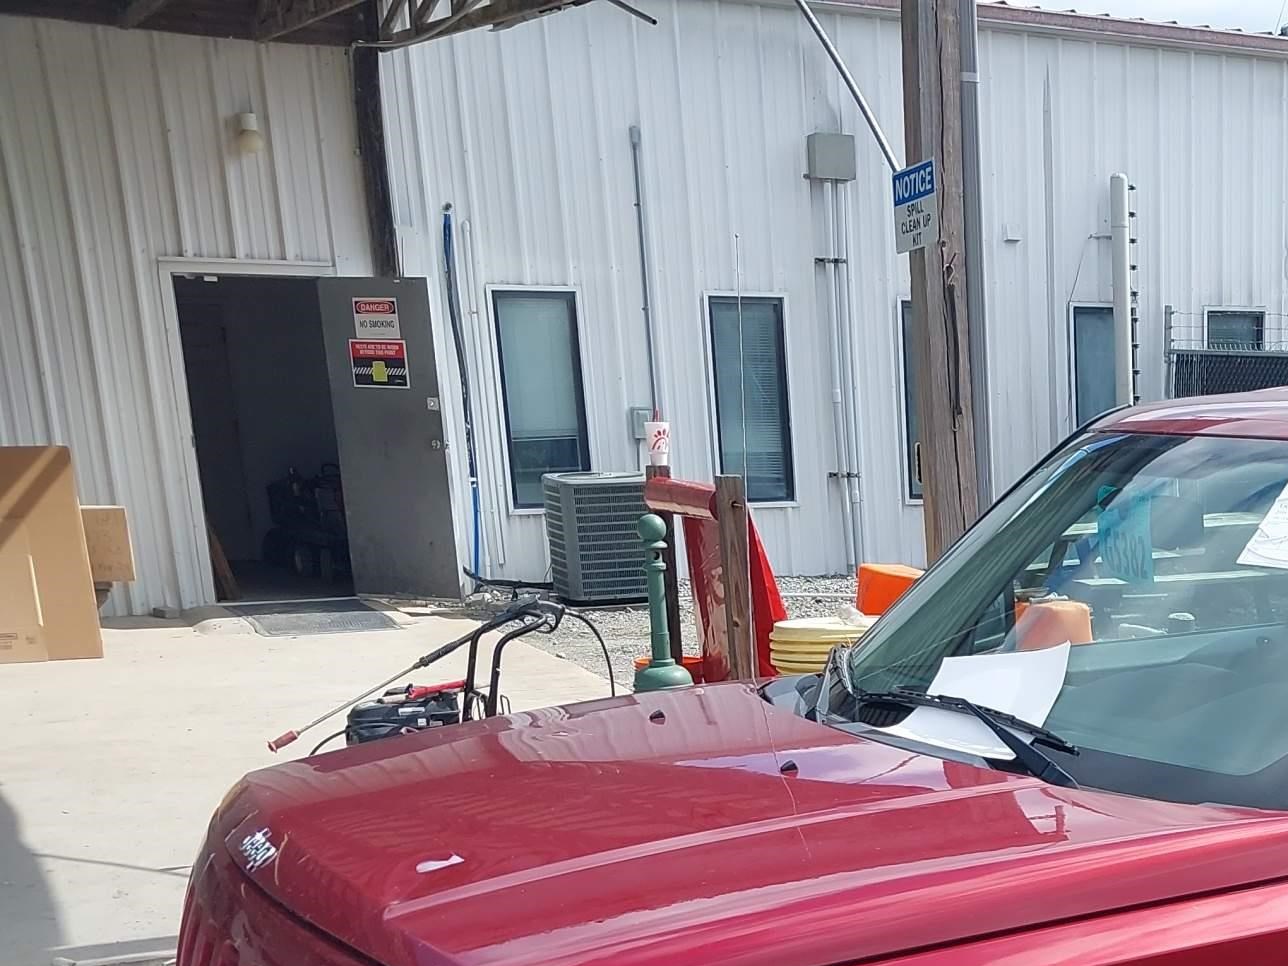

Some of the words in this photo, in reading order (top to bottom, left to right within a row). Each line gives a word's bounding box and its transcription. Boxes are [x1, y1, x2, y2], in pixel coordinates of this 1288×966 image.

[895, 166, 932, 202] NOTICE
[906, 200, 924, 217] SPILL
[901, 217, 921, 234] CLEAN
[922, 213, 931, 227] UP
[912, 231, 922, 247] KIT
[360, 303, 390, 312] DANGER
[359, 319, 368, 329] NO
[368, 319, 395, 329] SMOKING
